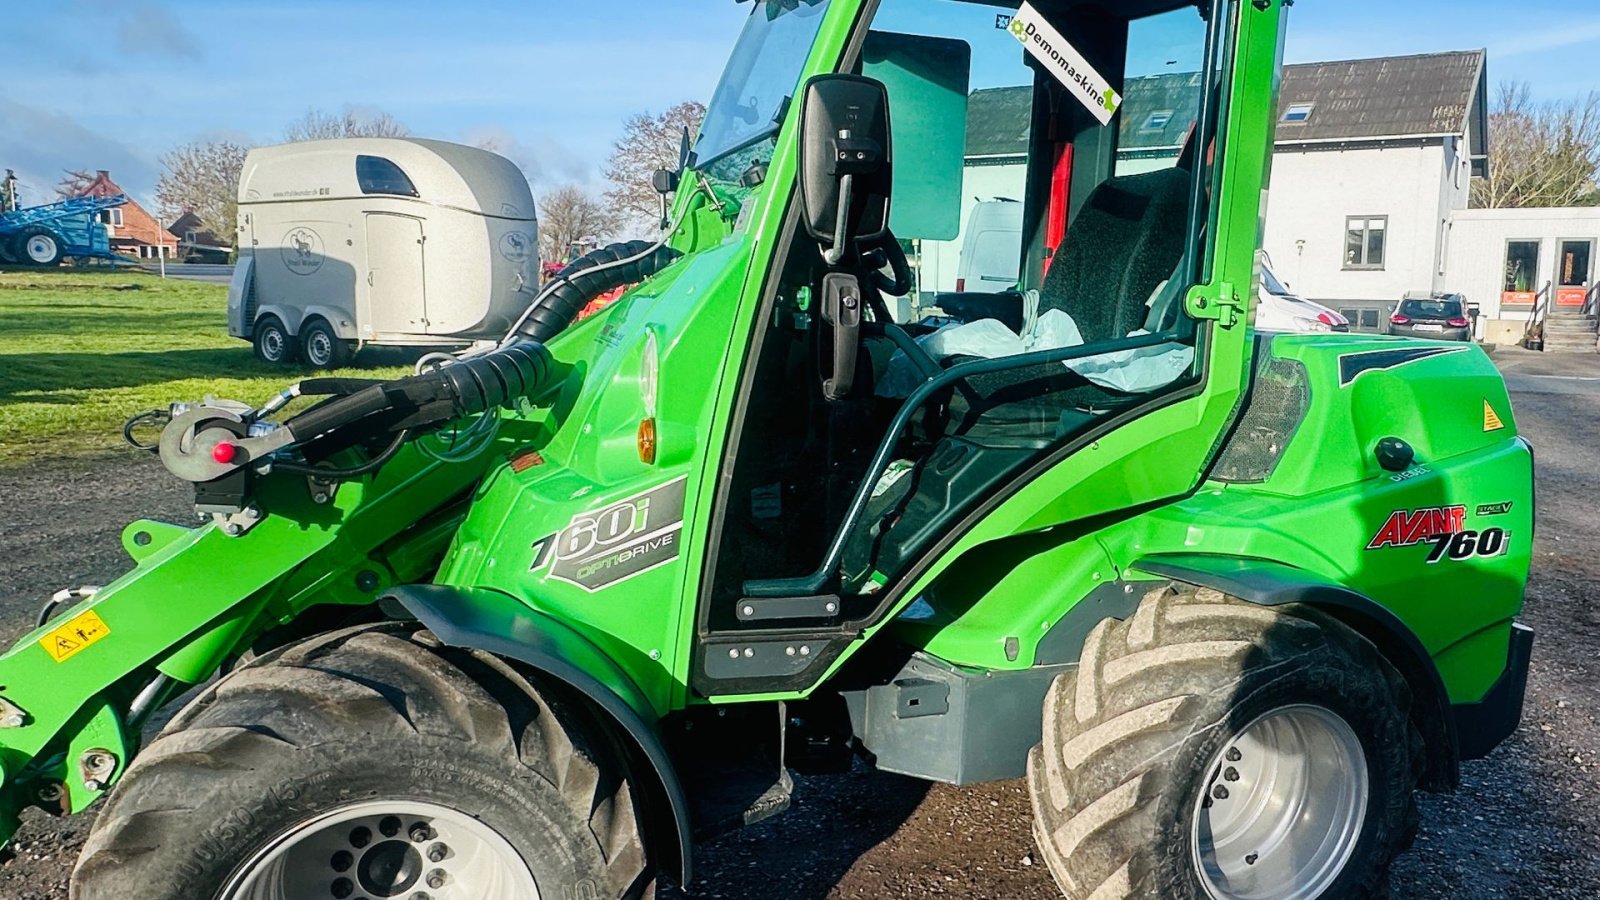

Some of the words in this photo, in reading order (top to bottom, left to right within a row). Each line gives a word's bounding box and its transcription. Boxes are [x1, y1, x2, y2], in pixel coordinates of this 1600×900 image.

[1025, 22, 1105, 107] Demomaskine
[1390, 462, 1431, 482] DIESEL
[528, 497, 650, 572] 760i
[1365, 504, 1467, 549] AVANT
[1425, 527, 1512, 564] 760i
[577, 533, 673, 579] OPTIDRIVE
